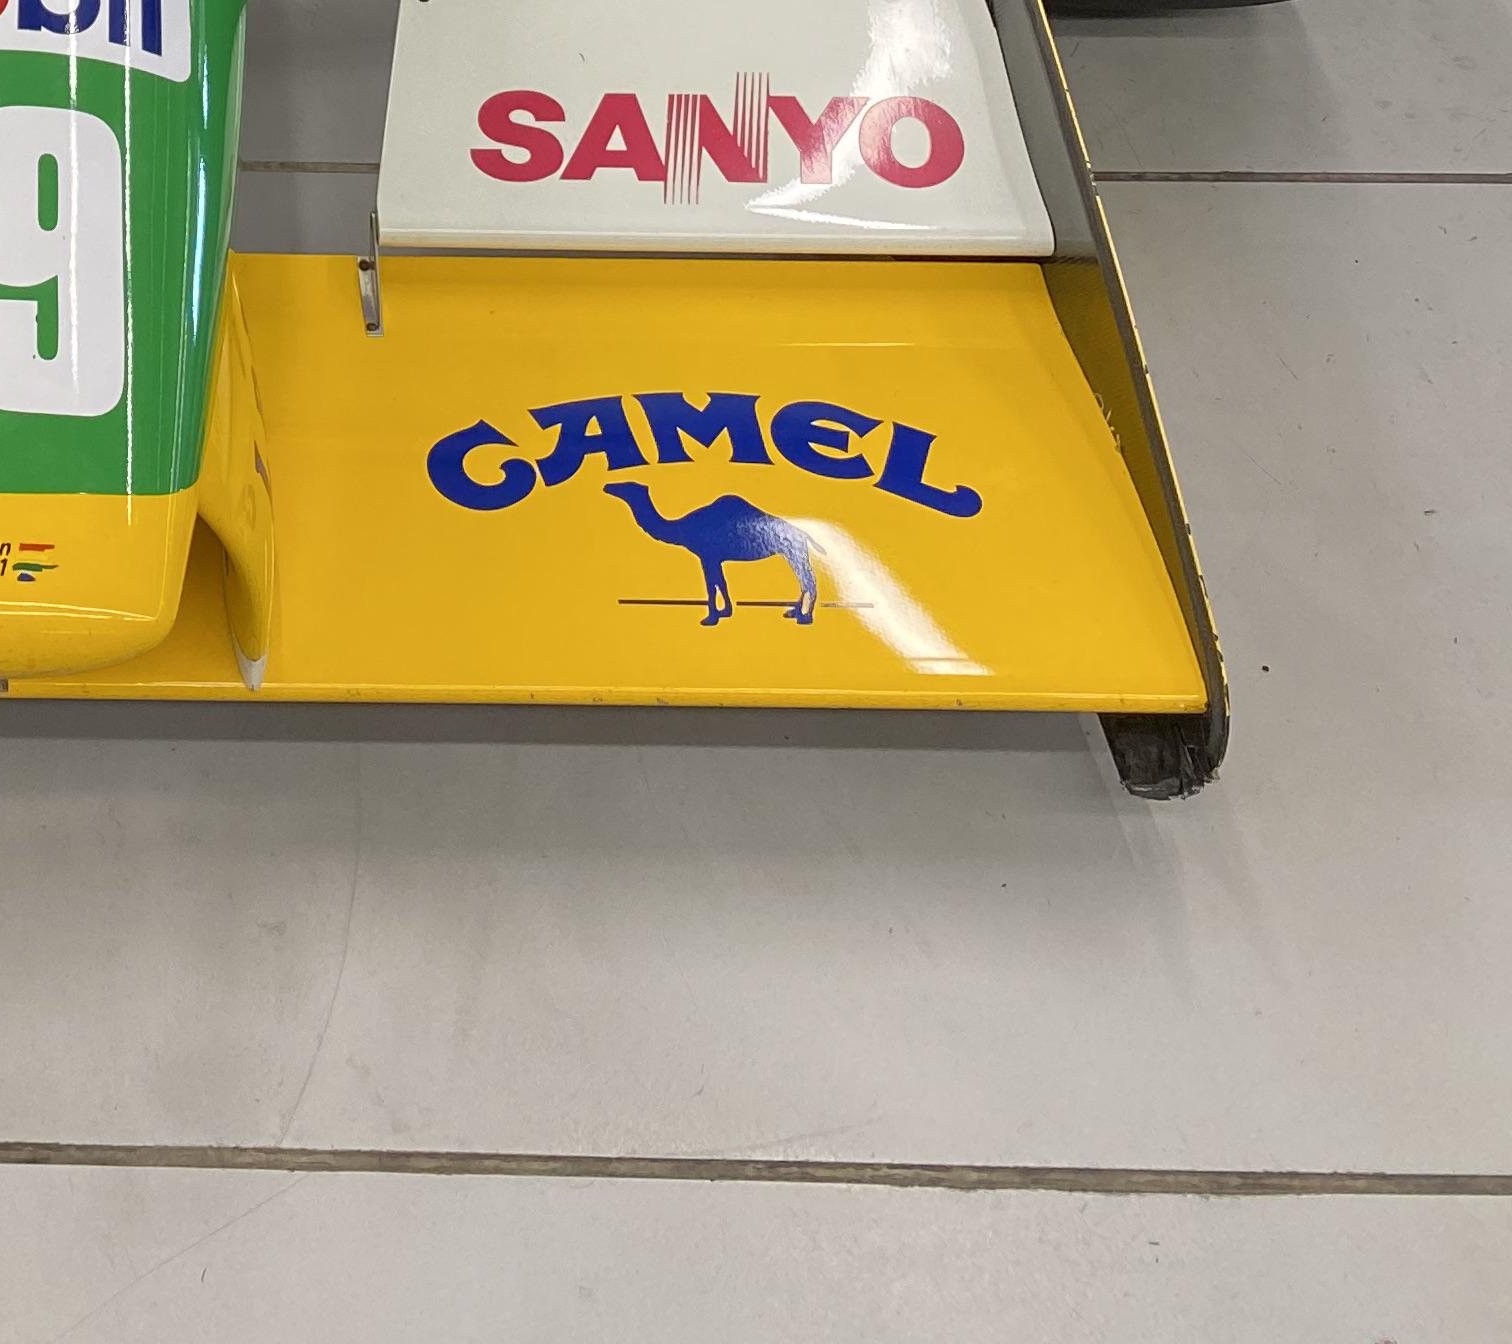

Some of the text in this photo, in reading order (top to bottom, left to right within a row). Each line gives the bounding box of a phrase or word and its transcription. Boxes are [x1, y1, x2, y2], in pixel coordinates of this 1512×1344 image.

[470, 71, 966, 206] SANYO
[426, 391, 984, 519] CAMEL
[0, 557, 8, 577] 1
